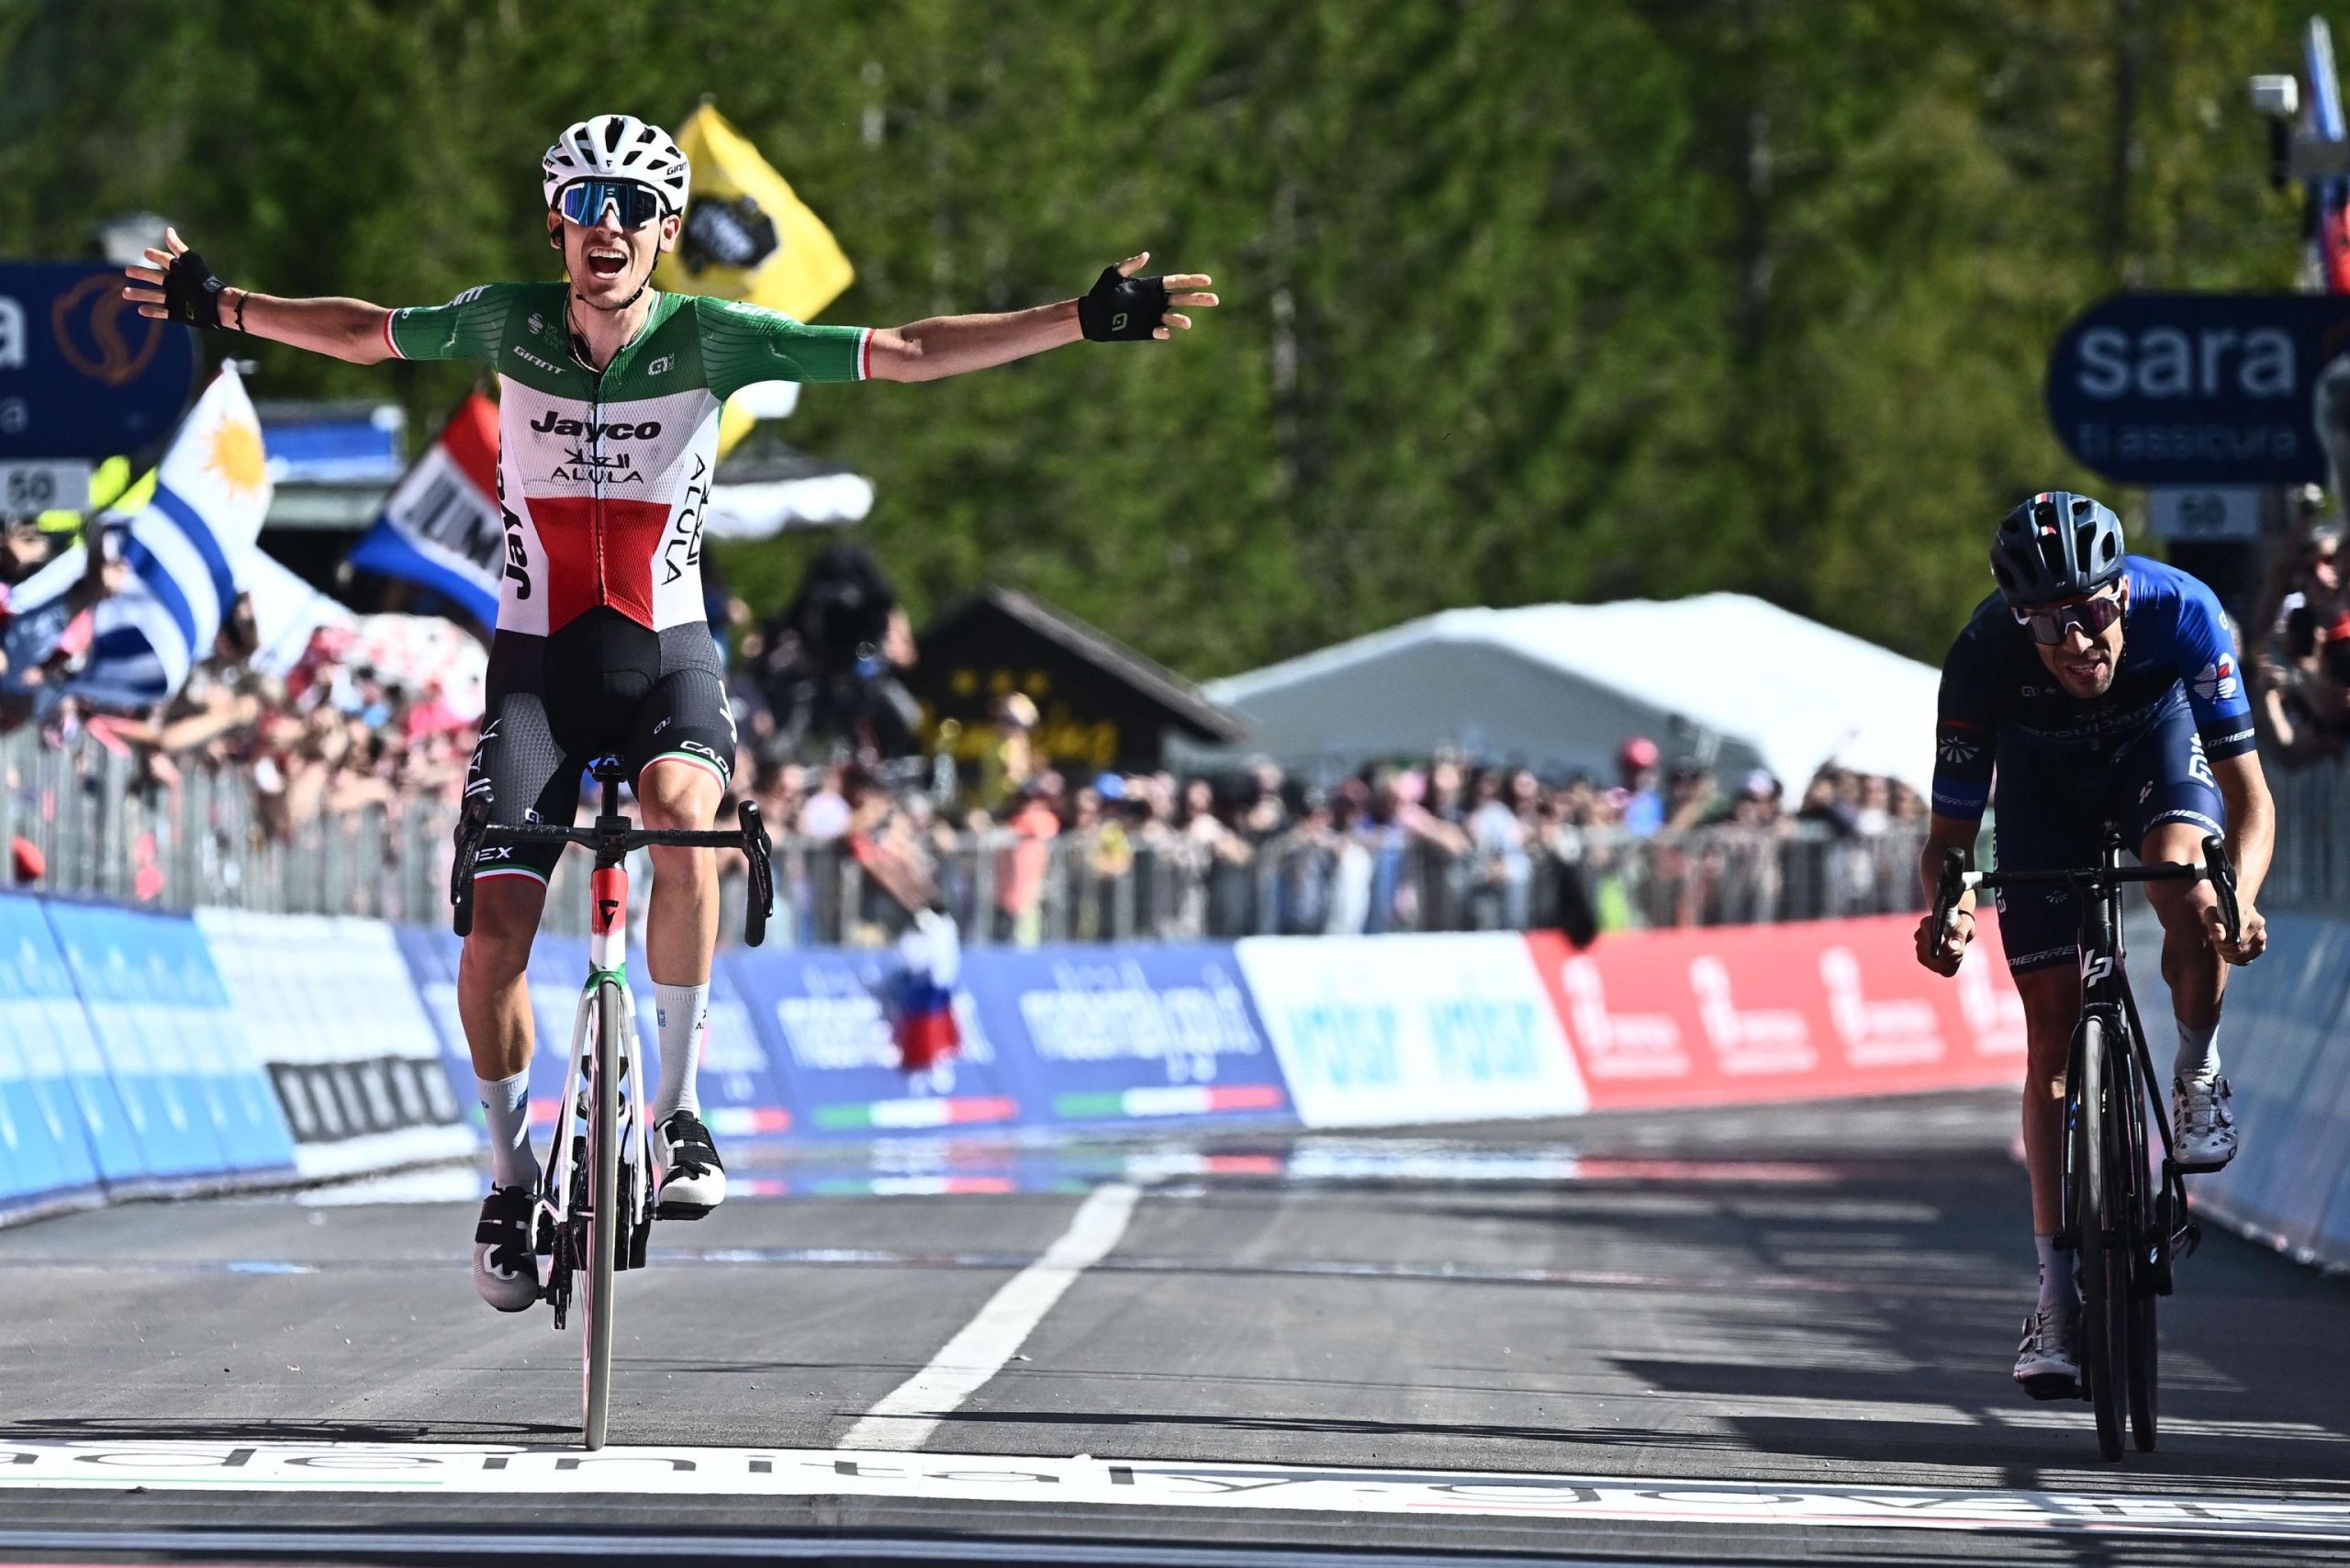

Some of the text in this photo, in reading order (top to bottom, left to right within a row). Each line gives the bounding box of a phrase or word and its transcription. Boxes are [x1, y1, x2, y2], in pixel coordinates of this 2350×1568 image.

[513, 345, 566, 375] GIANT
[2077, 324, 2298, 398] sara
[530, 410, 662, 442] Jayco
[551, 466, 643, 484] ALULA
